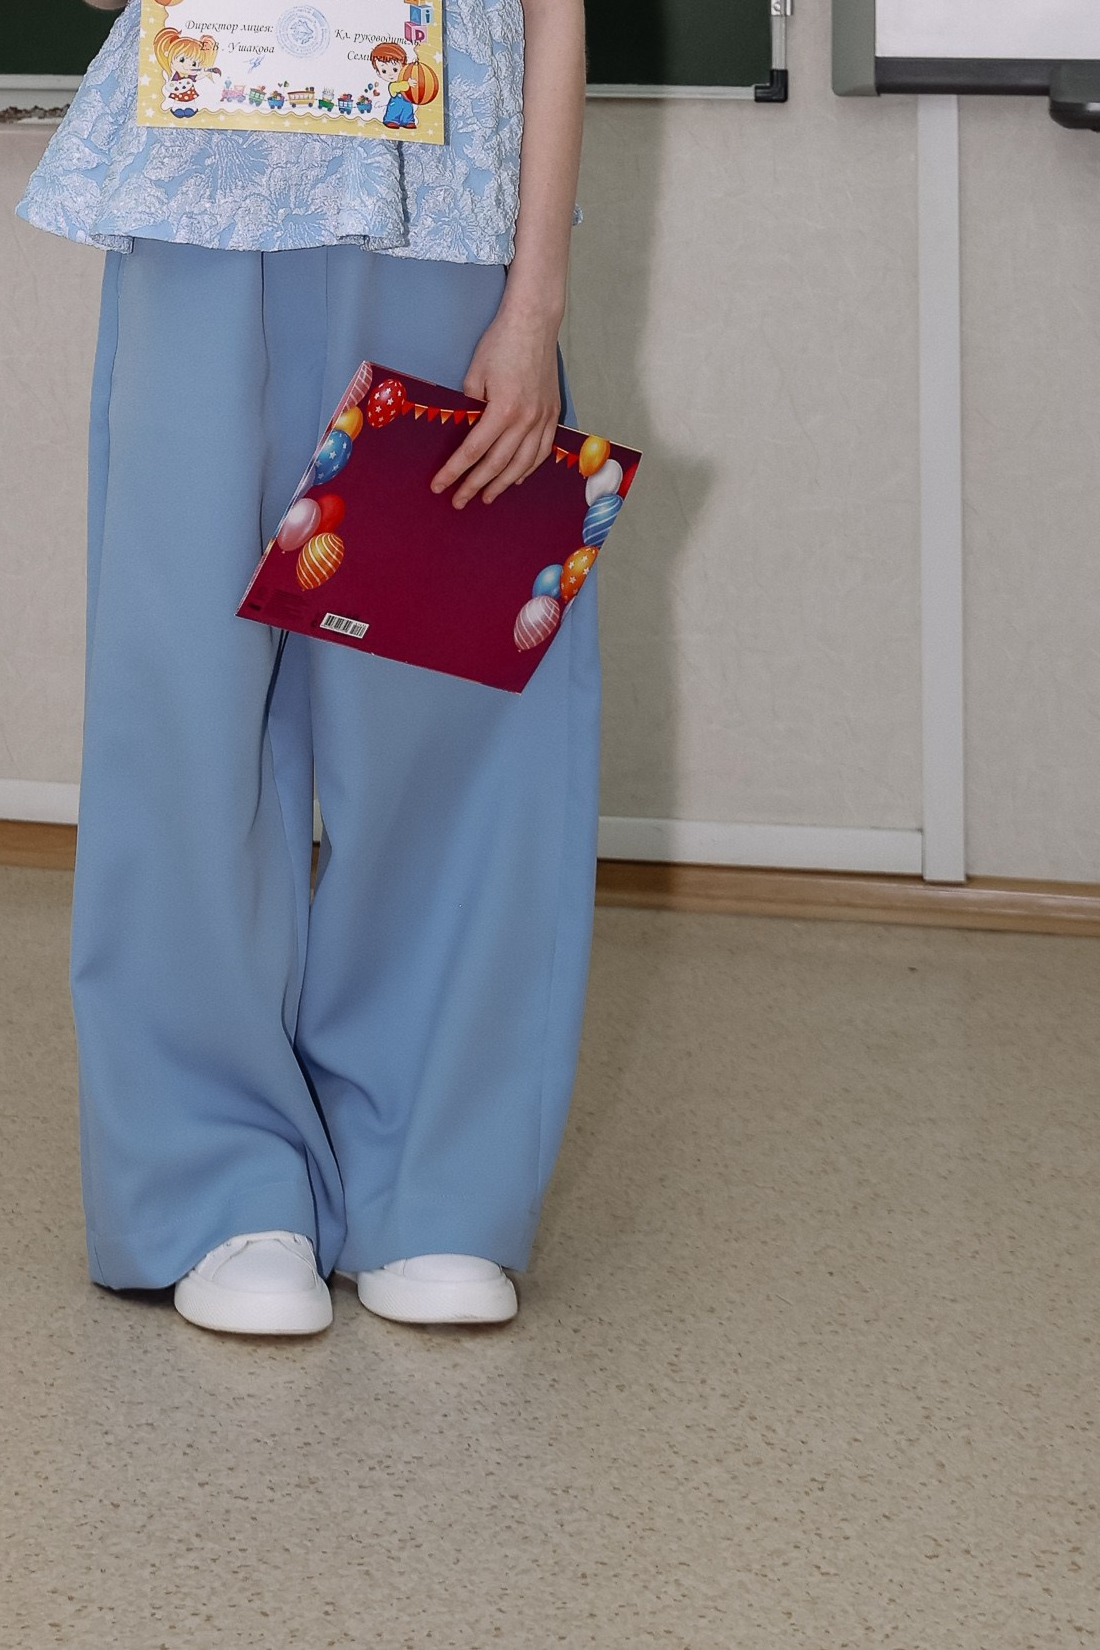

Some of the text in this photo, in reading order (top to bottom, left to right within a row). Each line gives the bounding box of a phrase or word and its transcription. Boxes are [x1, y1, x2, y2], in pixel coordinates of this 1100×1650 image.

[185, 20, 274, 34] Директор лицея:
[334, 29, 351, 41] Кл.
[228, 41, 275, 55] Ушакова
